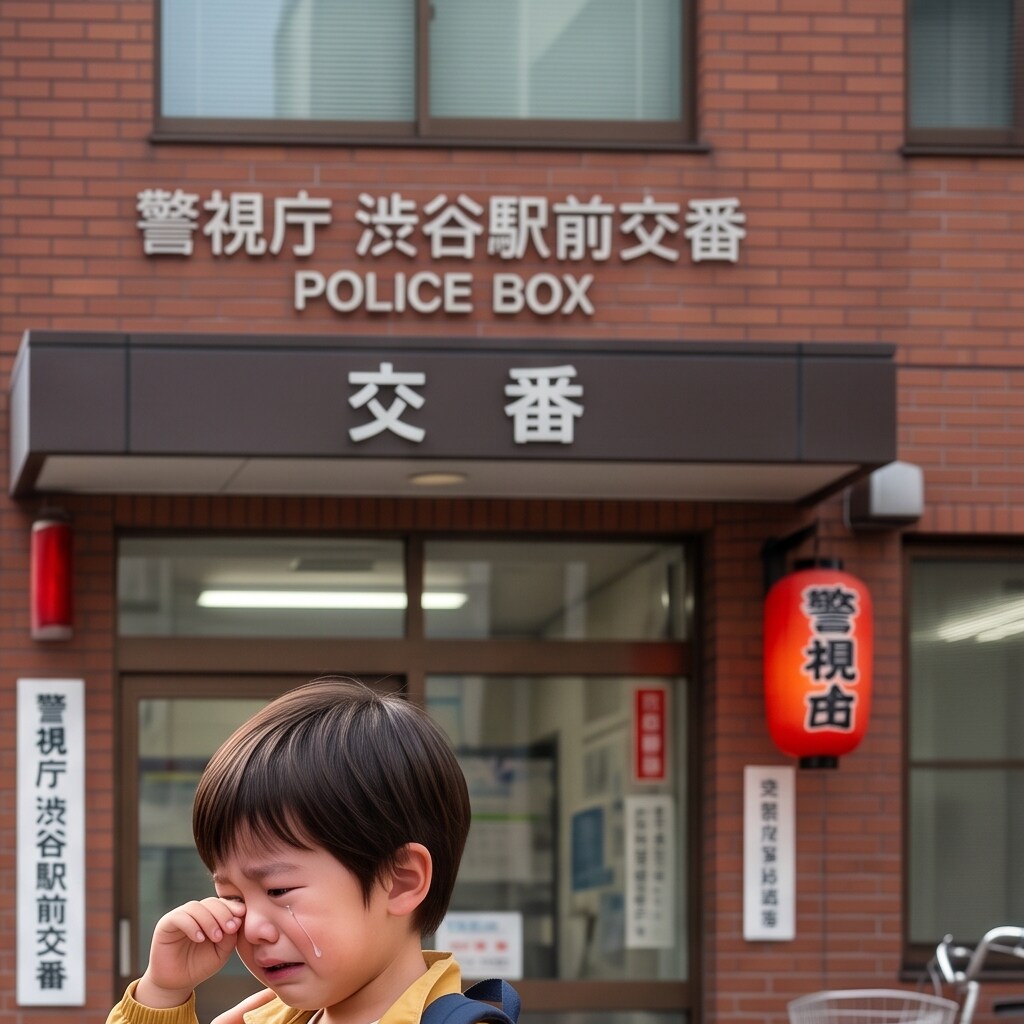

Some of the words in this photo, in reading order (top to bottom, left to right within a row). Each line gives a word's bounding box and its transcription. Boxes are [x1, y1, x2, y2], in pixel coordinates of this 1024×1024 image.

[137, 189, 331, 256] 警視庁
[356, 193, 746, 262] 渋谷駅前交番
[295, 270, 473, 313] POLICE
[493, 273, 594, 315] BOX
